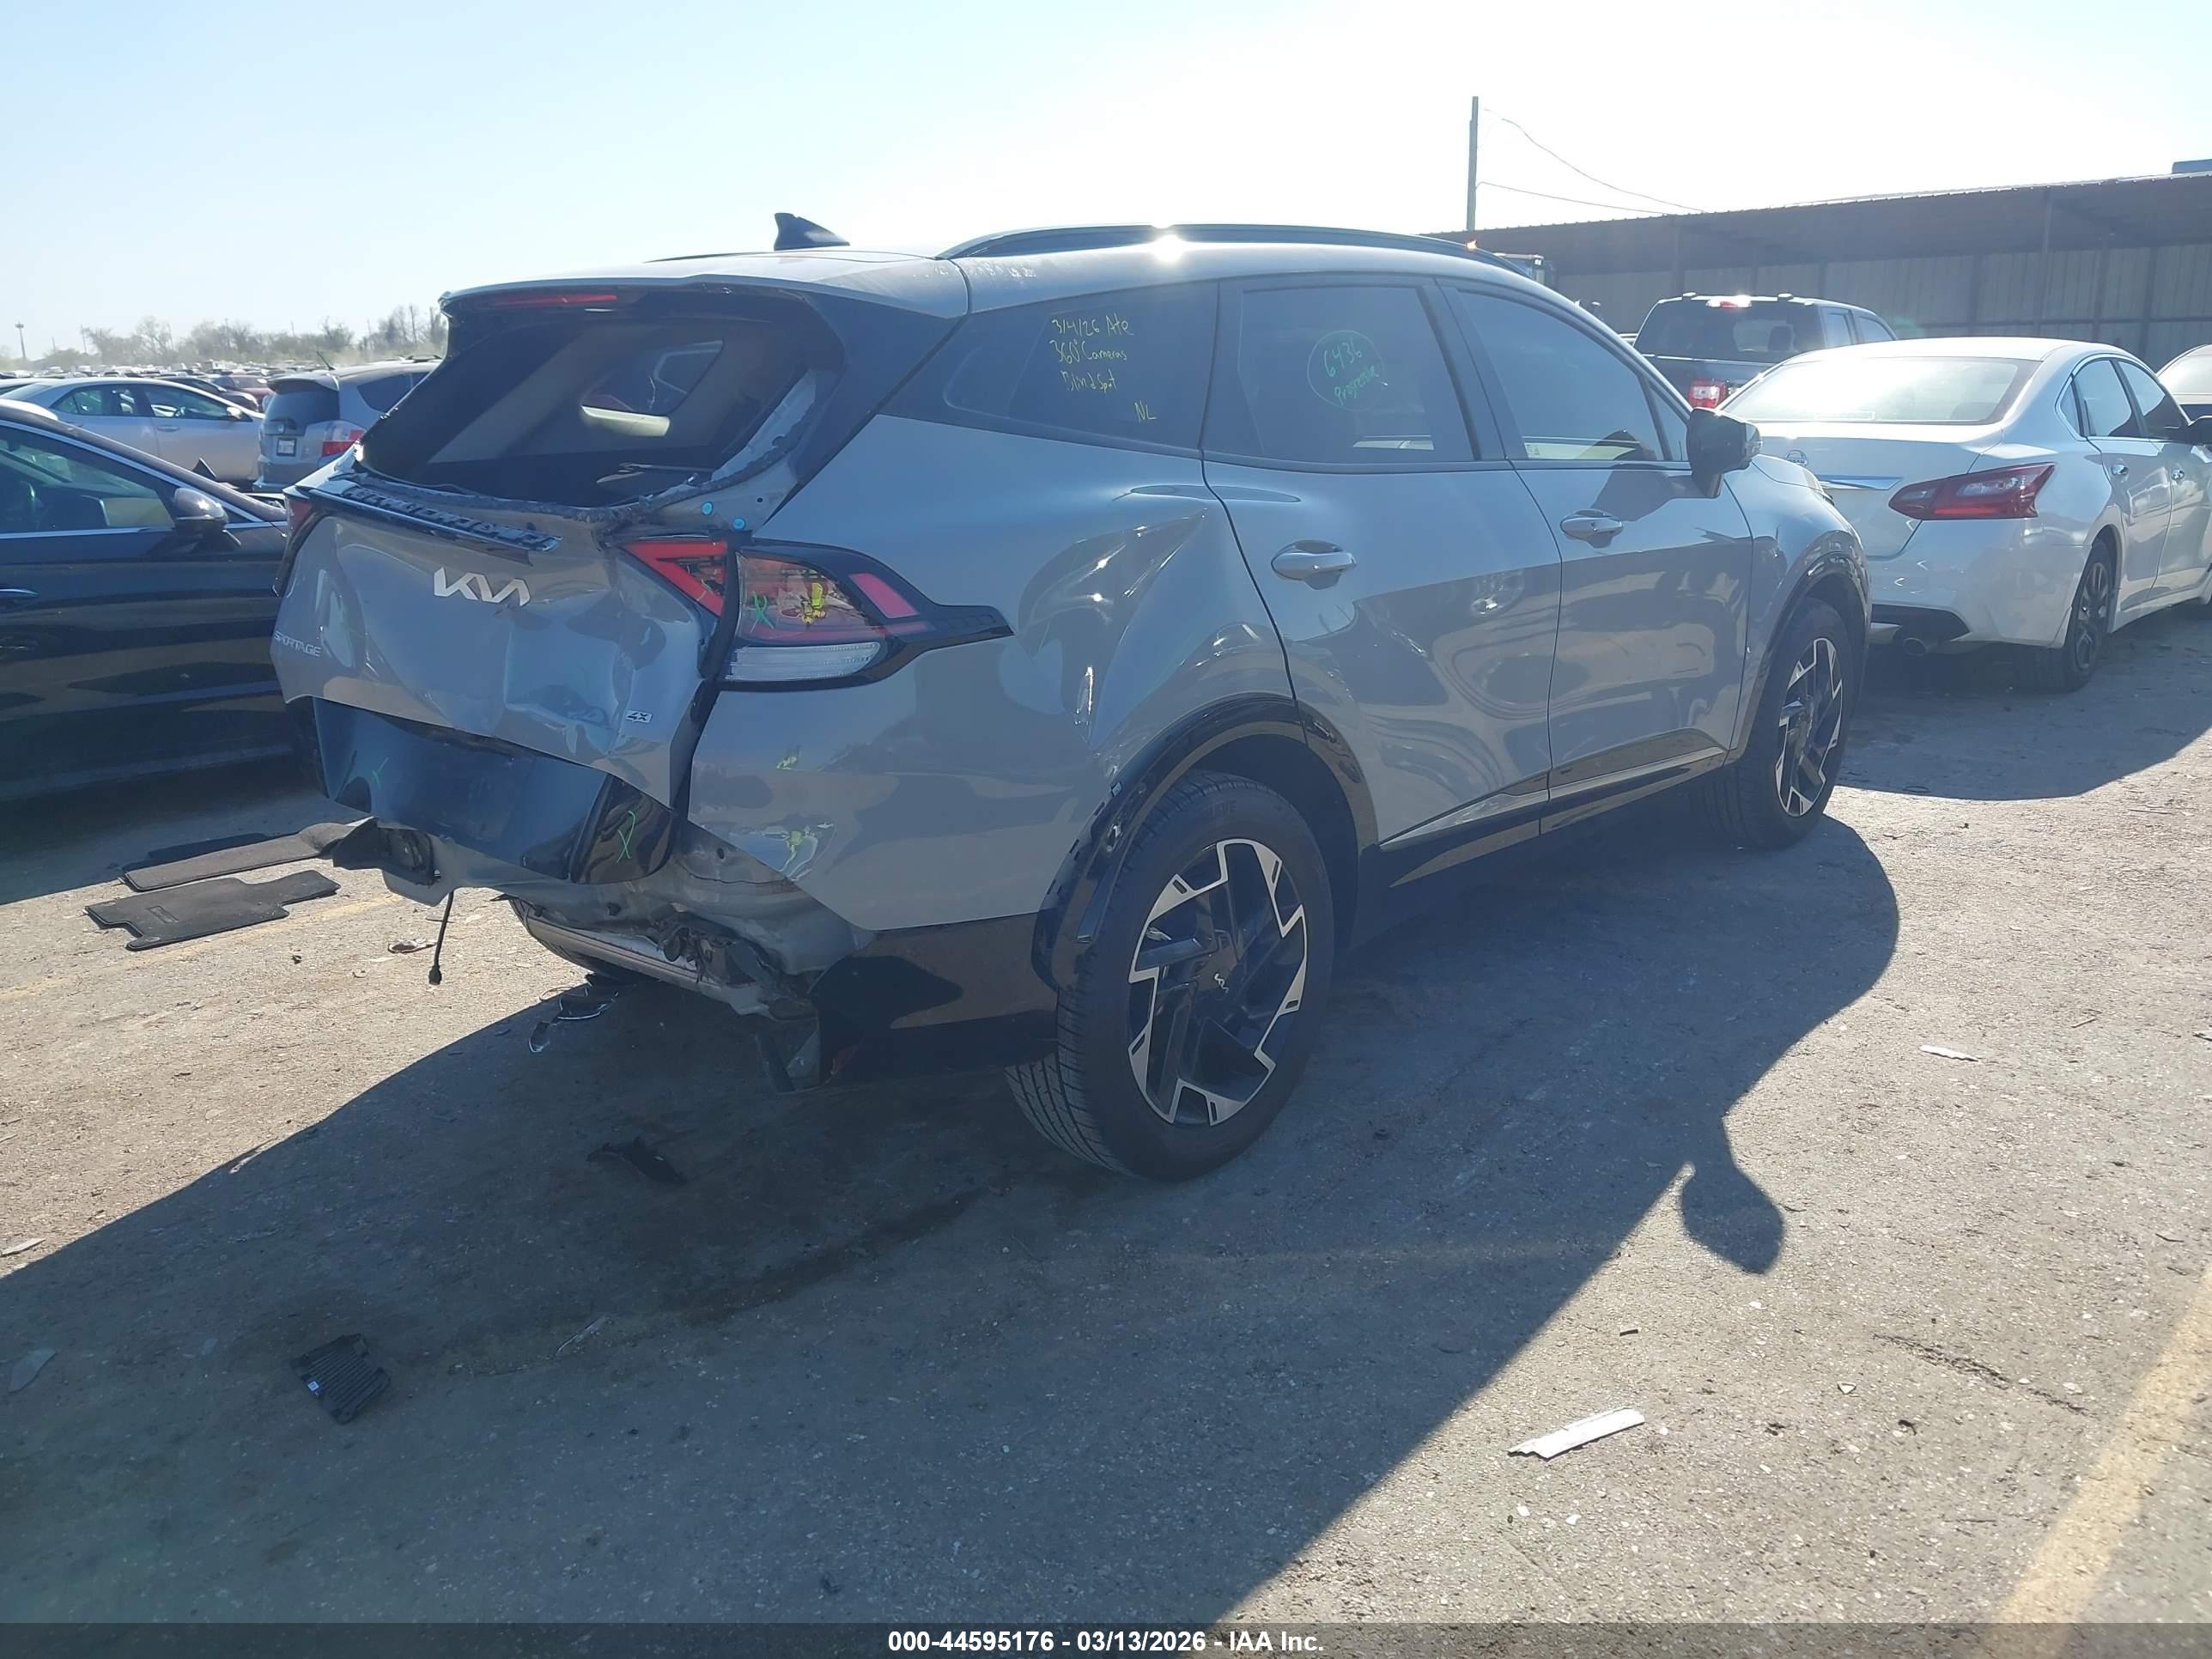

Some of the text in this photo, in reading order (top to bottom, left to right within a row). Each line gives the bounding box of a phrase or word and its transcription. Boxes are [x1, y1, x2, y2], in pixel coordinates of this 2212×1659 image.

[1051, 319, 1100, 337] 3/4/26
[1323, 337, 1363, 377] 6436
[1133, 400, 1158, 422] NL
[274, 629, 323, 657] SORTAGE
